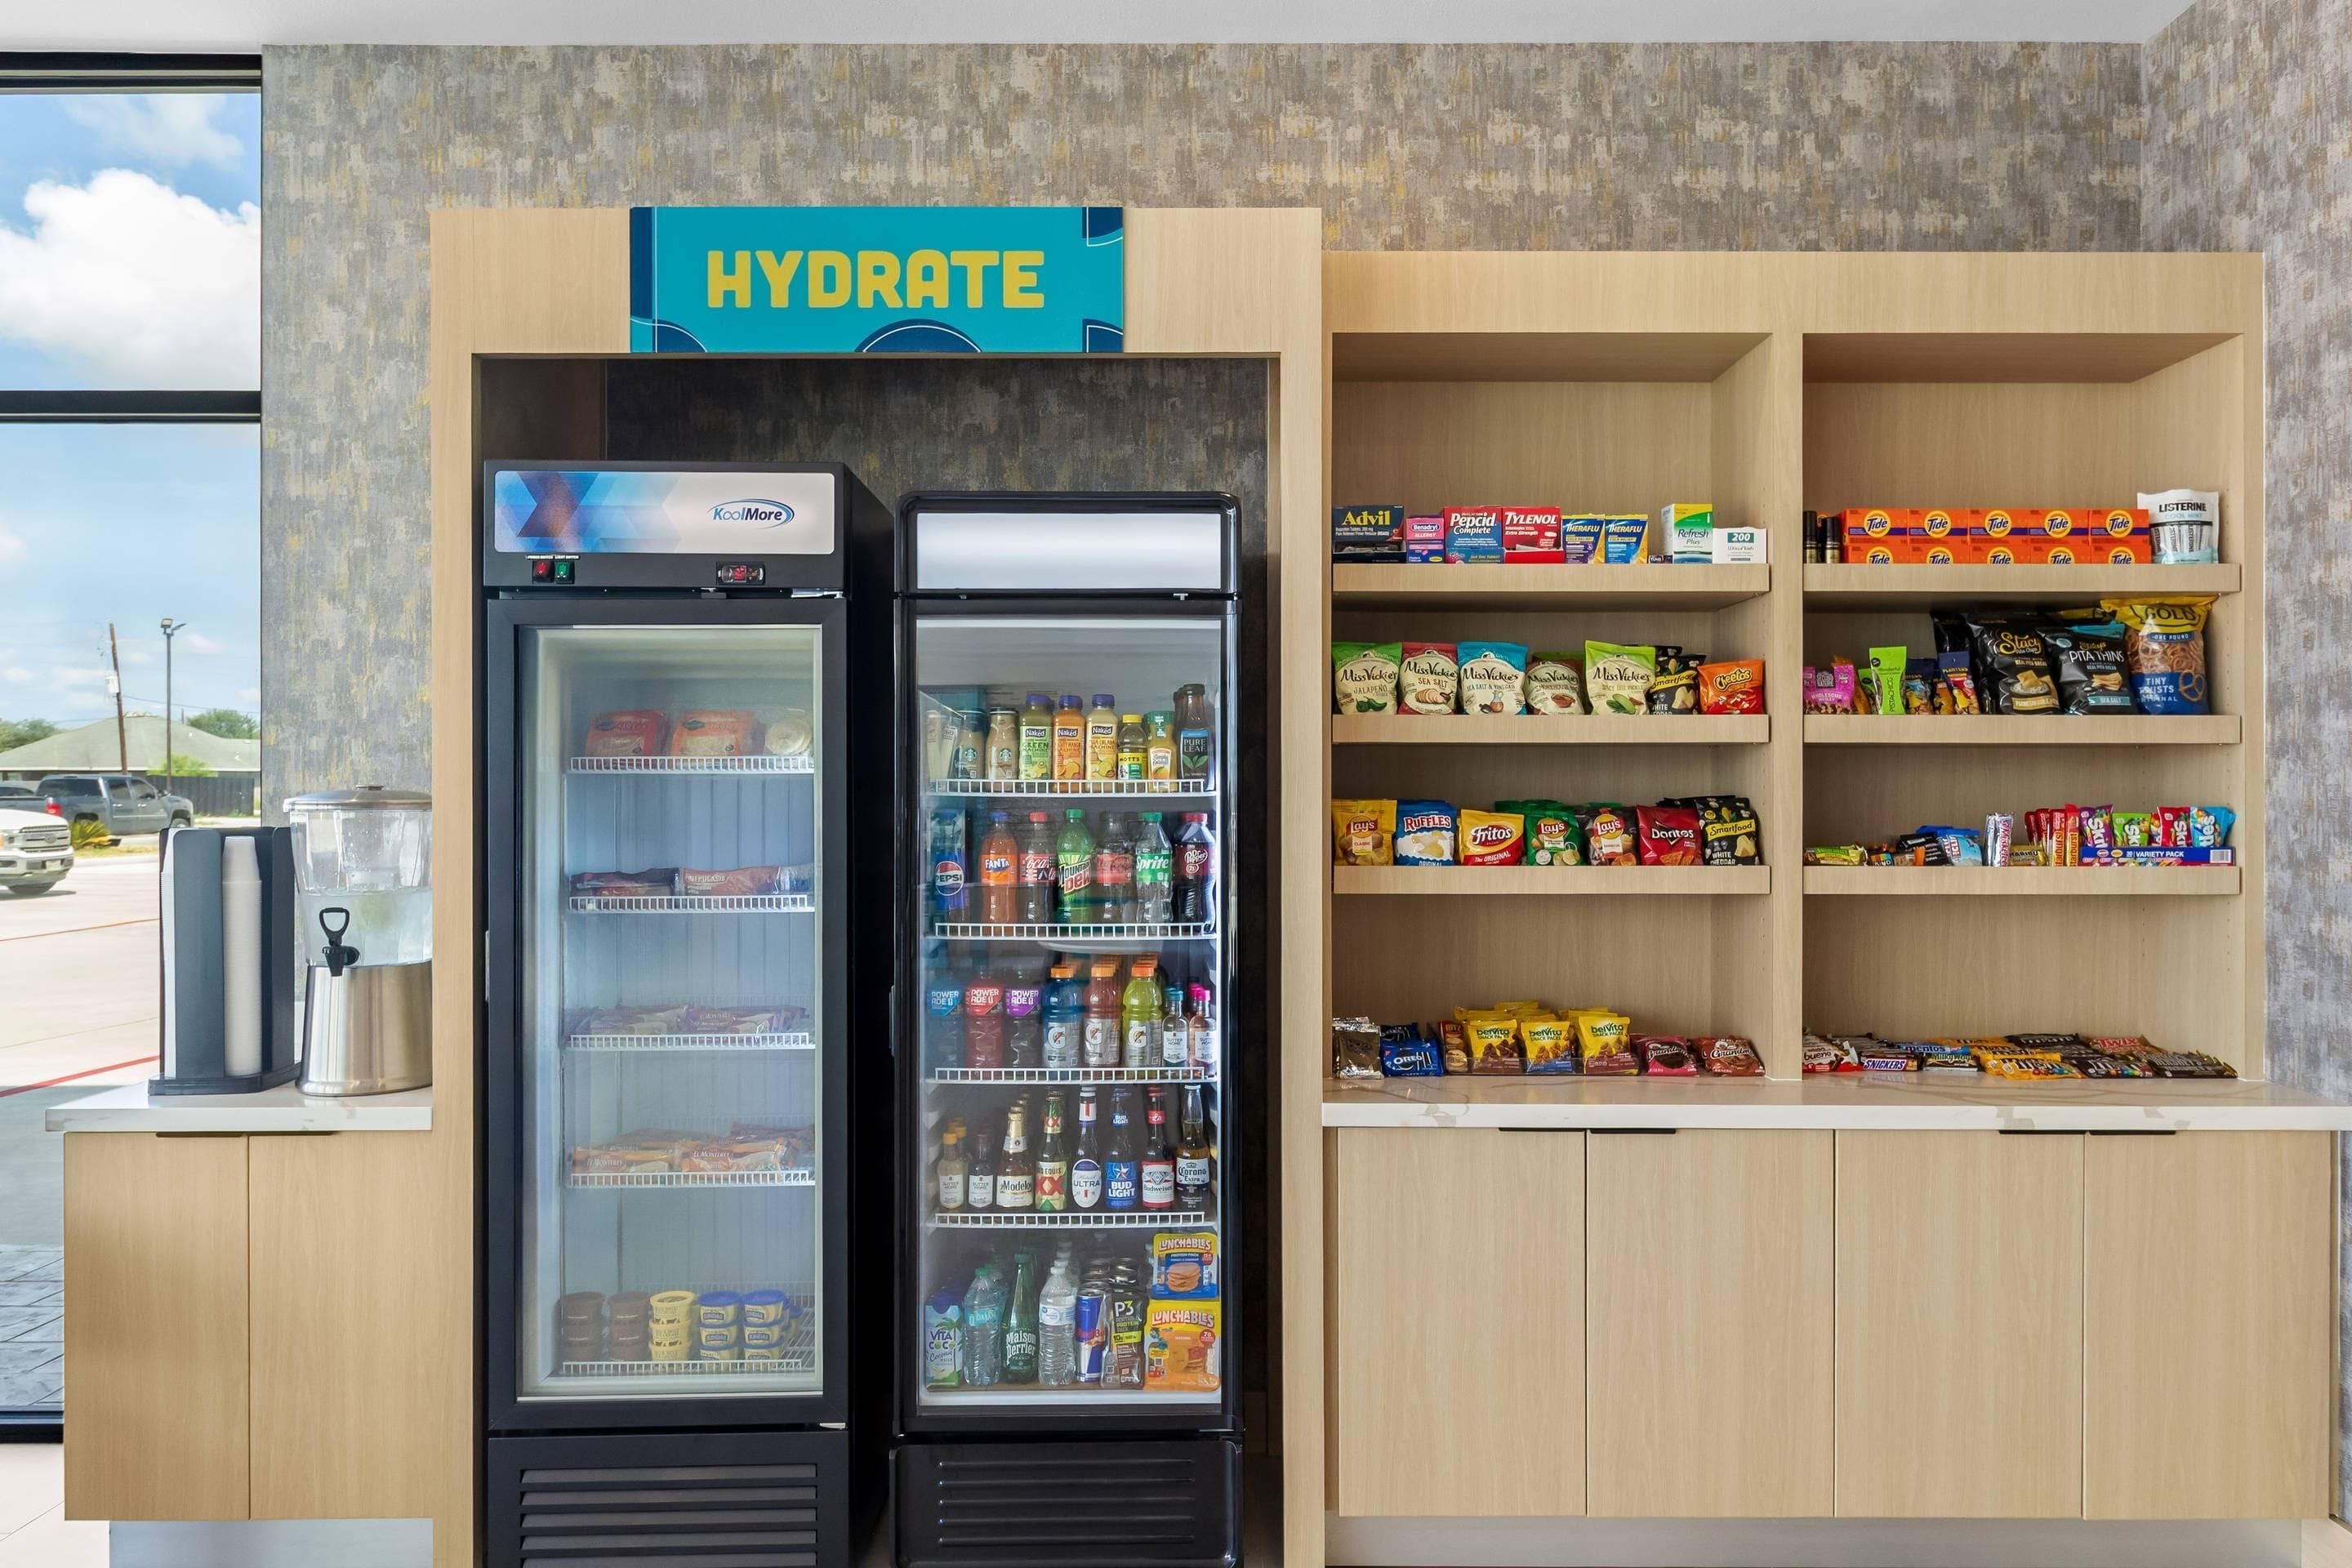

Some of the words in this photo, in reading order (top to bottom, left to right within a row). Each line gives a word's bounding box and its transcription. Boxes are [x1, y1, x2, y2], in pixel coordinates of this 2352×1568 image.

[707, 250, 1045, 309] HYDRATE
[2158, 502, 2207, 513] LISTERINE
[712, 507, 782, 522] KoolMore
[1342, 510, 1391, 525] Advil
[1450, 512, 1496, 528] Pepcid
[1504, 511, 1558, 525] TYLENOL
[1454, 526, 1491, 536] Complete
[1566, 523, 1600, 532] THERAFLU
[1608, 523, 1642, 532] THERAFLU
[1867, 518, 1887, 532] Tide
[1927, 518, 1948, 532] Tide
[1988, 518, 2008, 532] Tide
[2047, 518, 2069, 532] Tide
[2109, 518, 2130, 532] Tide
[1677, 529, 1708, 537] Refresh
[1731, 533, 1750, 541] 200
[2145, 606, 2196, 621] GOLD
[2069, 650, 2095, 663] PITA
[2095, 650, 2124, 662] THINS
[1404, 661, 1428, 675] Miss
[1340, 669, 1367, 682] Miss
[1363, 666, 1397, 684] Vickie's
[1463, 667, 1490, 681] Miss
[1483, 667, 1519, 684] Vickie's
[1528, 675, 1551, 684] Miss
[1592, 666, 1621, 681] Miss
[1616, 667, 1650, 684] Vickie's
[1715, 669, 1751, 690] Cheetos
[2145, 677, 2167, 685] TINY
[1433, 678, 1448, 688] SALT
[1058, 728, 1078, 737] Naked
[1092, 726, 1112, 734] Naked
[1350, 821, 1374, 833] Lay's
[1404, 815, 1451, 832] RUFFLES
[1541, 822, 1565, 834] Lay's
[1597, 819, 1621, 835] Lay's
[1710, 822, 1753, 837] Smartfood
[1471, 825, 1512, 844] Fritos
[1651, 827, 1694, 840] Doritos
[1483, 850, 1511, 862] ORIGINAL
[985, 858, 1010, 869] FANTA
[1136, 856, 1169, 872] Sprite
[936, 874, 962, 882] PEPSI
[1477, 1027, 1509, 1036] belVita
[1529, 1027, 1562, 1037] belVita
[1590, 1022, 1624, 1034] belVita
[2098, 1038, 2137, 1047] TWIX
[1393, 1054, 1423, 1065] OREO
[1803, 1050, 1831, 1061] bueno
[1864, 1059, 1905, 1070] SNICKERS
[702, 1150, 730, 1158] MONTEREY
[1178, 1166, 1207, 1177] Corona
[1000, 1180, 1032, 1191] Modelo
[1111, 1181, 1133, 1189] BUD
[1108, 1188, 1135, 1197] LIGHT
[1159, 1237, 1211, 1251] LUNCHABLES
[1114, 1300, 1134, 1317] P3
[1152, 1310, 1214, 1328] LUNCHABLES
[930, 1330, 952, 1341] VITA
[1005, 1330, 1036, 1343] Maison
[929, 1341, 956, 1350] COCO
